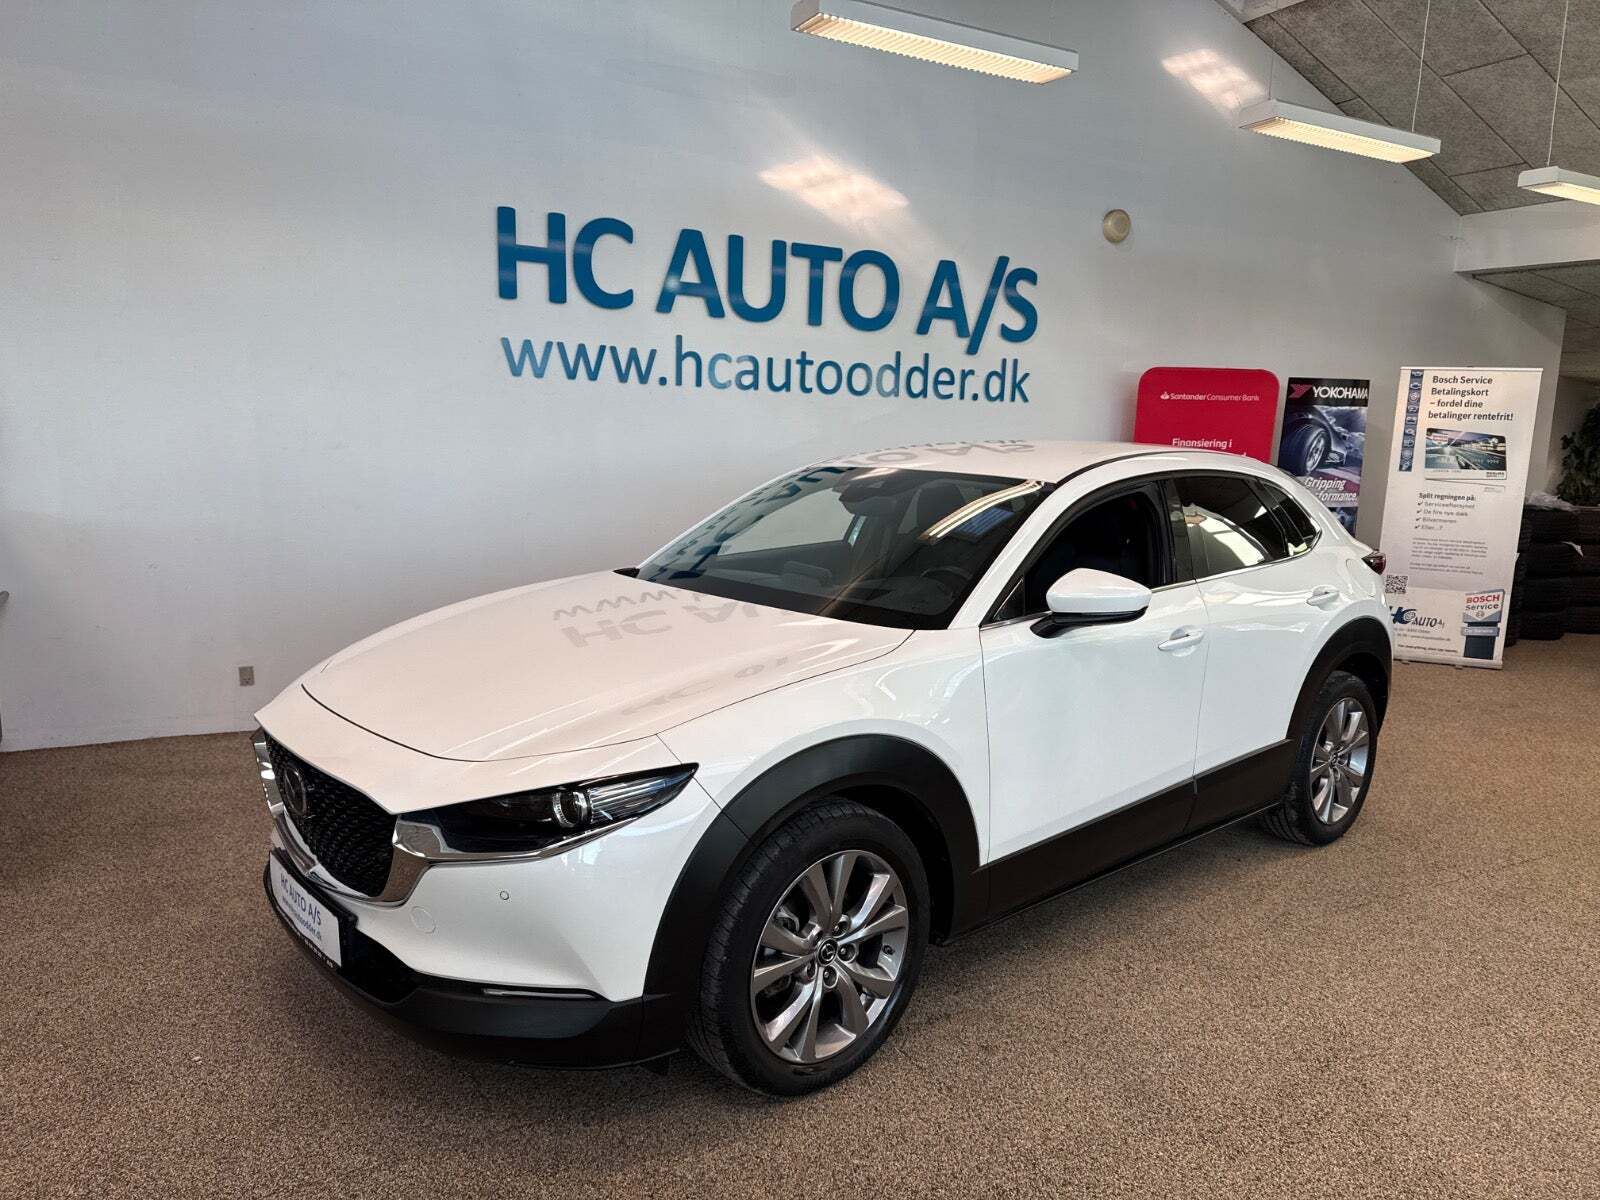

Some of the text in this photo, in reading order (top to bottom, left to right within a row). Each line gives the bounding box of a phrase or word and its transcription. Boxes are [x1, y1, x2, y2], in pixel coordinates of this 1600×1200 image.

[497, 206, 1039, 356] HC AUTO A/S
[500, 335, 1031, 404] www.hcautoodder.dk
[1432, 375, 1493, 385] Bosch Service
[1170, 392, 1206, 401] Santander
[1206, 393, 1242, 401] Consumer
[1312, 386, 1368, 400] YOKOHAMA
[1431, 387, 1489, 397] Betalingskort
[1437, 399, 1463, 408] fordel
[1464, 400, 1484, 408] dine
[1428, 410, 1514, 421] betalinger rentefrit!
[1172, 438, 1233, 450] Finansiering i
[1304, 477, 1347, 491] Gripping
[1315, 490, 1358, 502] formance.
[1466, 594, 1500, 604] BOSCH
[1465, 603, 1500, 611] Service
[1411, 617, 1438, 628] AUTO
[280, 873, 289, 893] HC
[289, 884, 307, 912] AUTO
[308, 903, 322, 926] A/S
